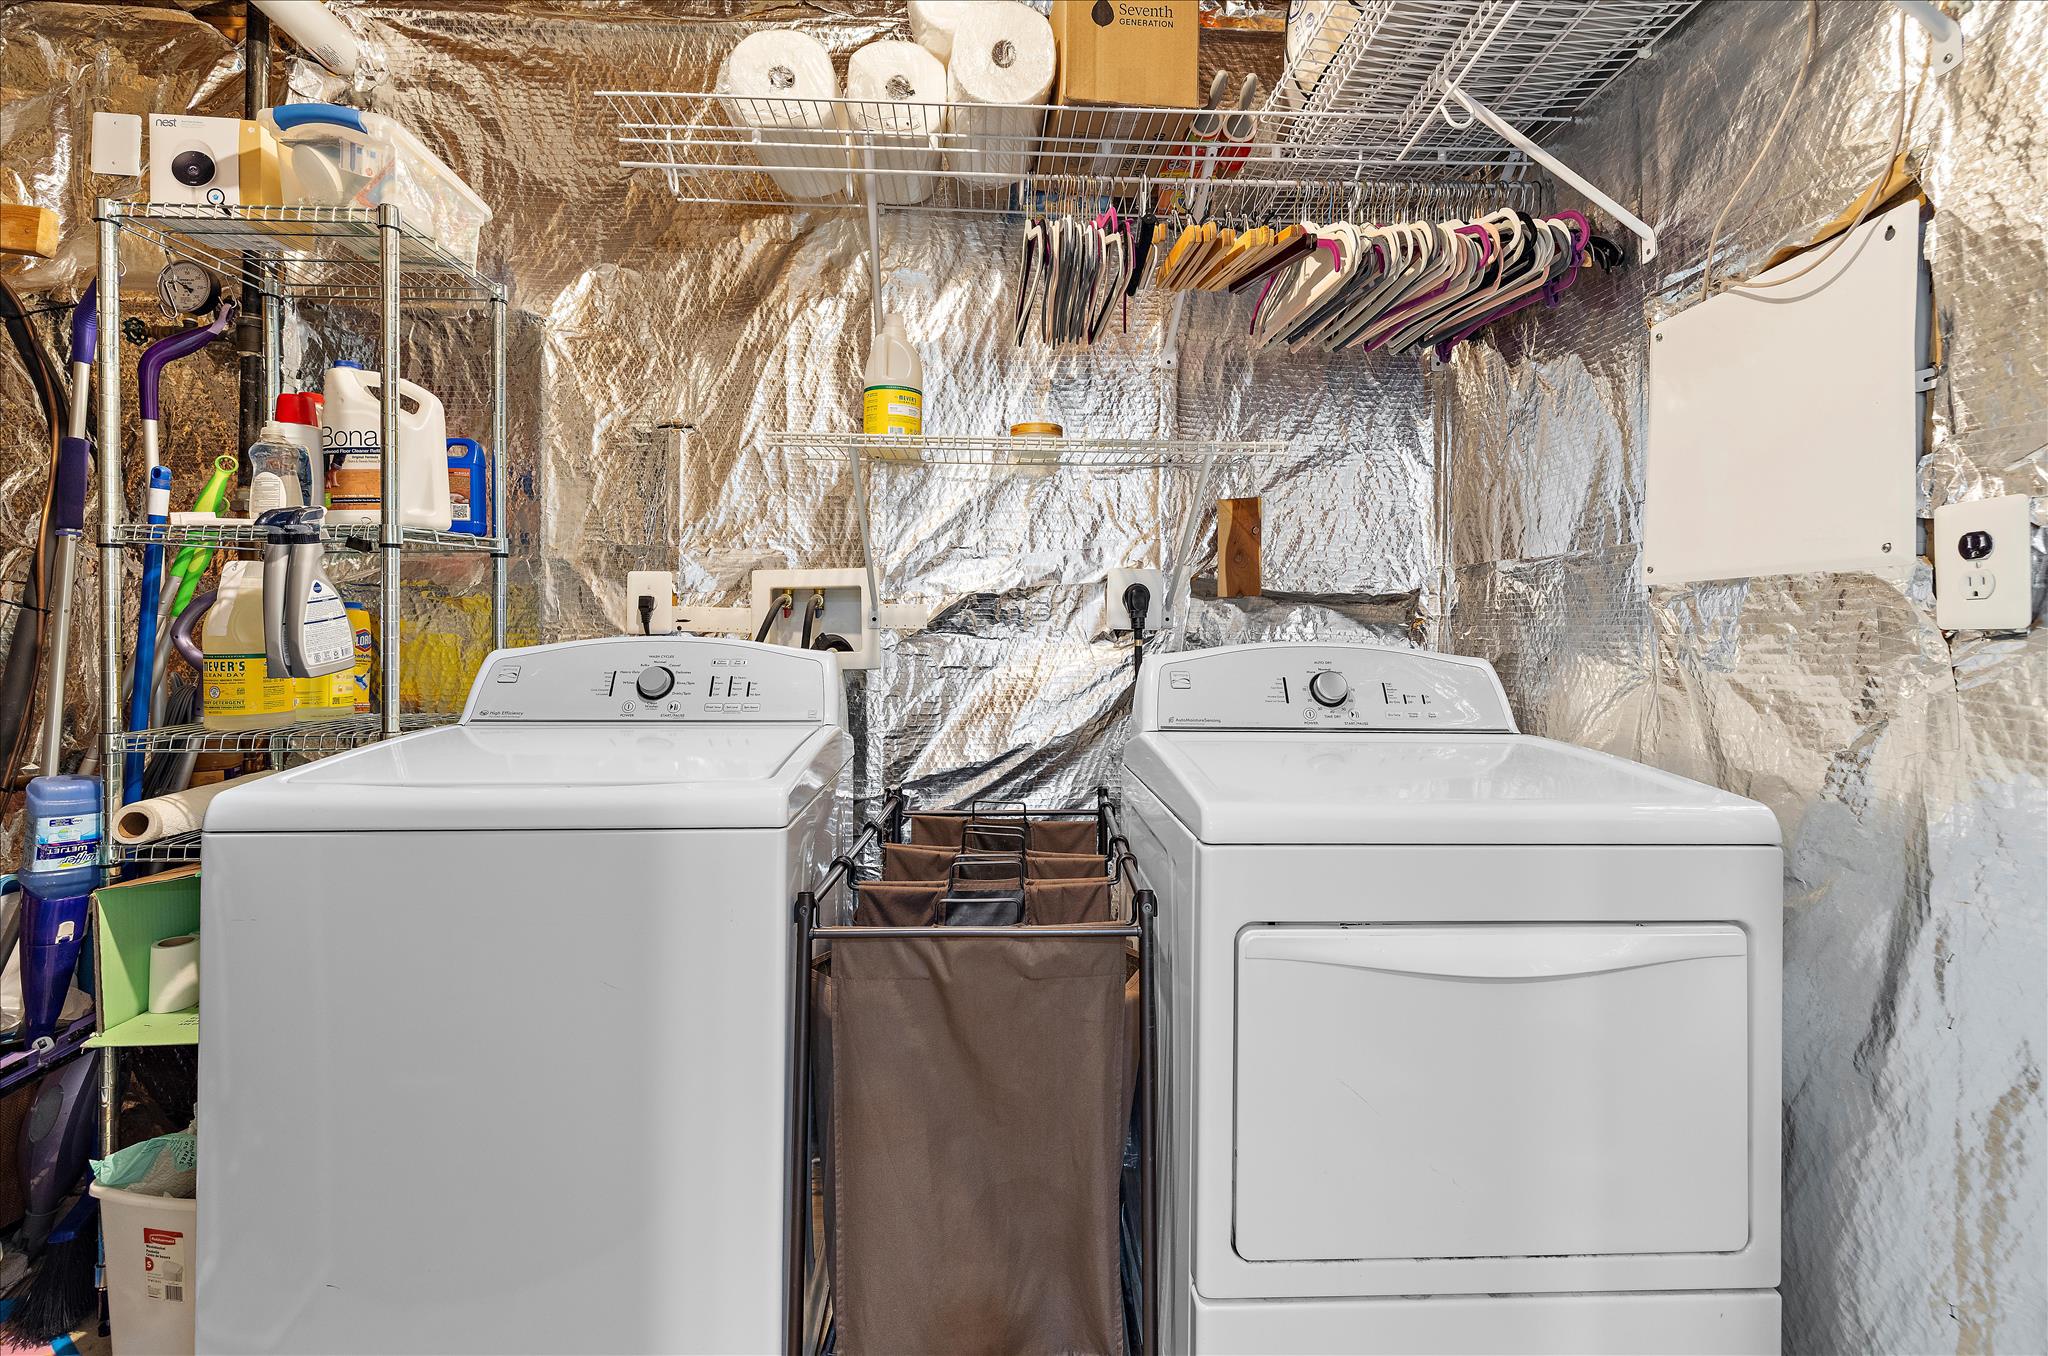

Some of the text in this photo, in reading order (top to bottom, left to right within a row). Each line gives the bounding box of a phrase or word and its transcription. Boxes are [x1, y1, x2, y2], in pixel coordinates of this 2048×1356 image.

[1119, 3, 1174, 18] Seventh
[1119, 18, 1174, 28] GENERATION
[155, 118, 177, 128] nest
